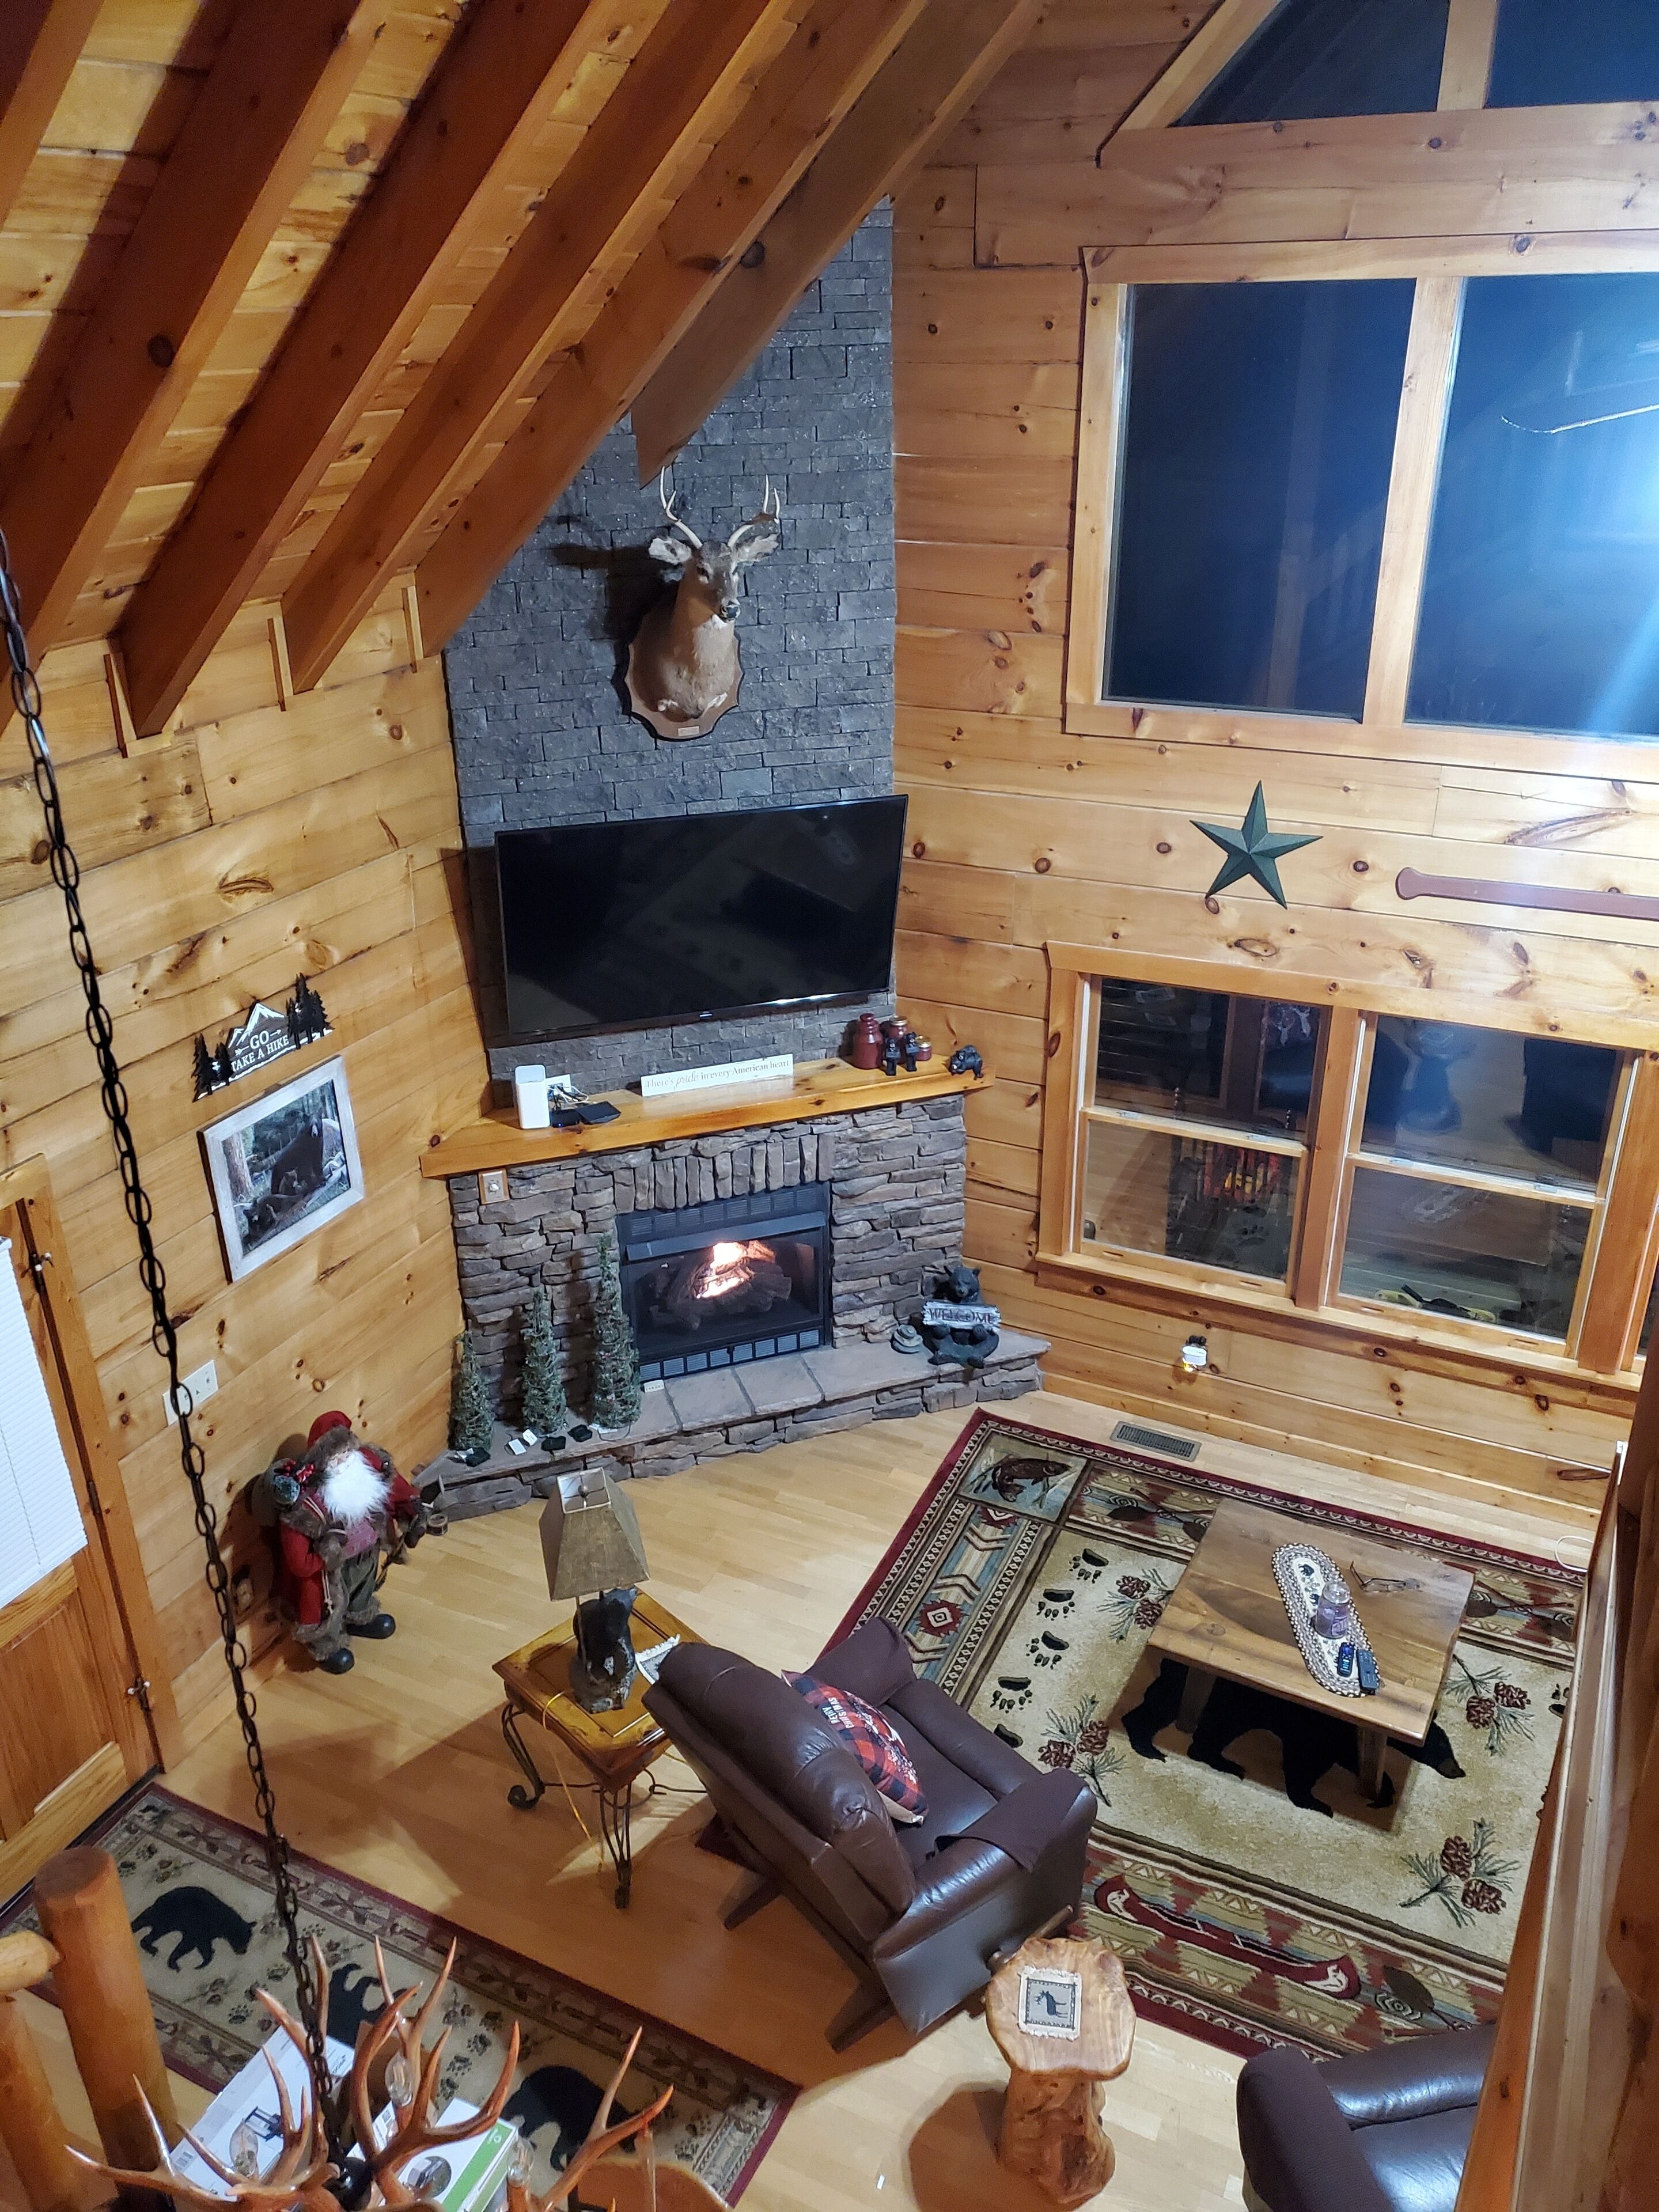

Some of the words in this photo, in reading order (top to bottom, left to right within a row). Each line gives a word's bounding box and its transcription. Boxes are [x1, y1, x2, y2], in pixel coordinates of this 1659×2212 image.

[230, 1052, 256, 1072] TAKE
[257, 1048, 265, 1059] A
[266, 1035, 289, 1055] HIKE
[250, 1030, 269, 1049] GO
[673, 1071, 700, 1090] pride
[708, 1070, 731, 1079] every
[732, 1064, 768, 1075] American
[770, 1060, 789, 1069] heart
